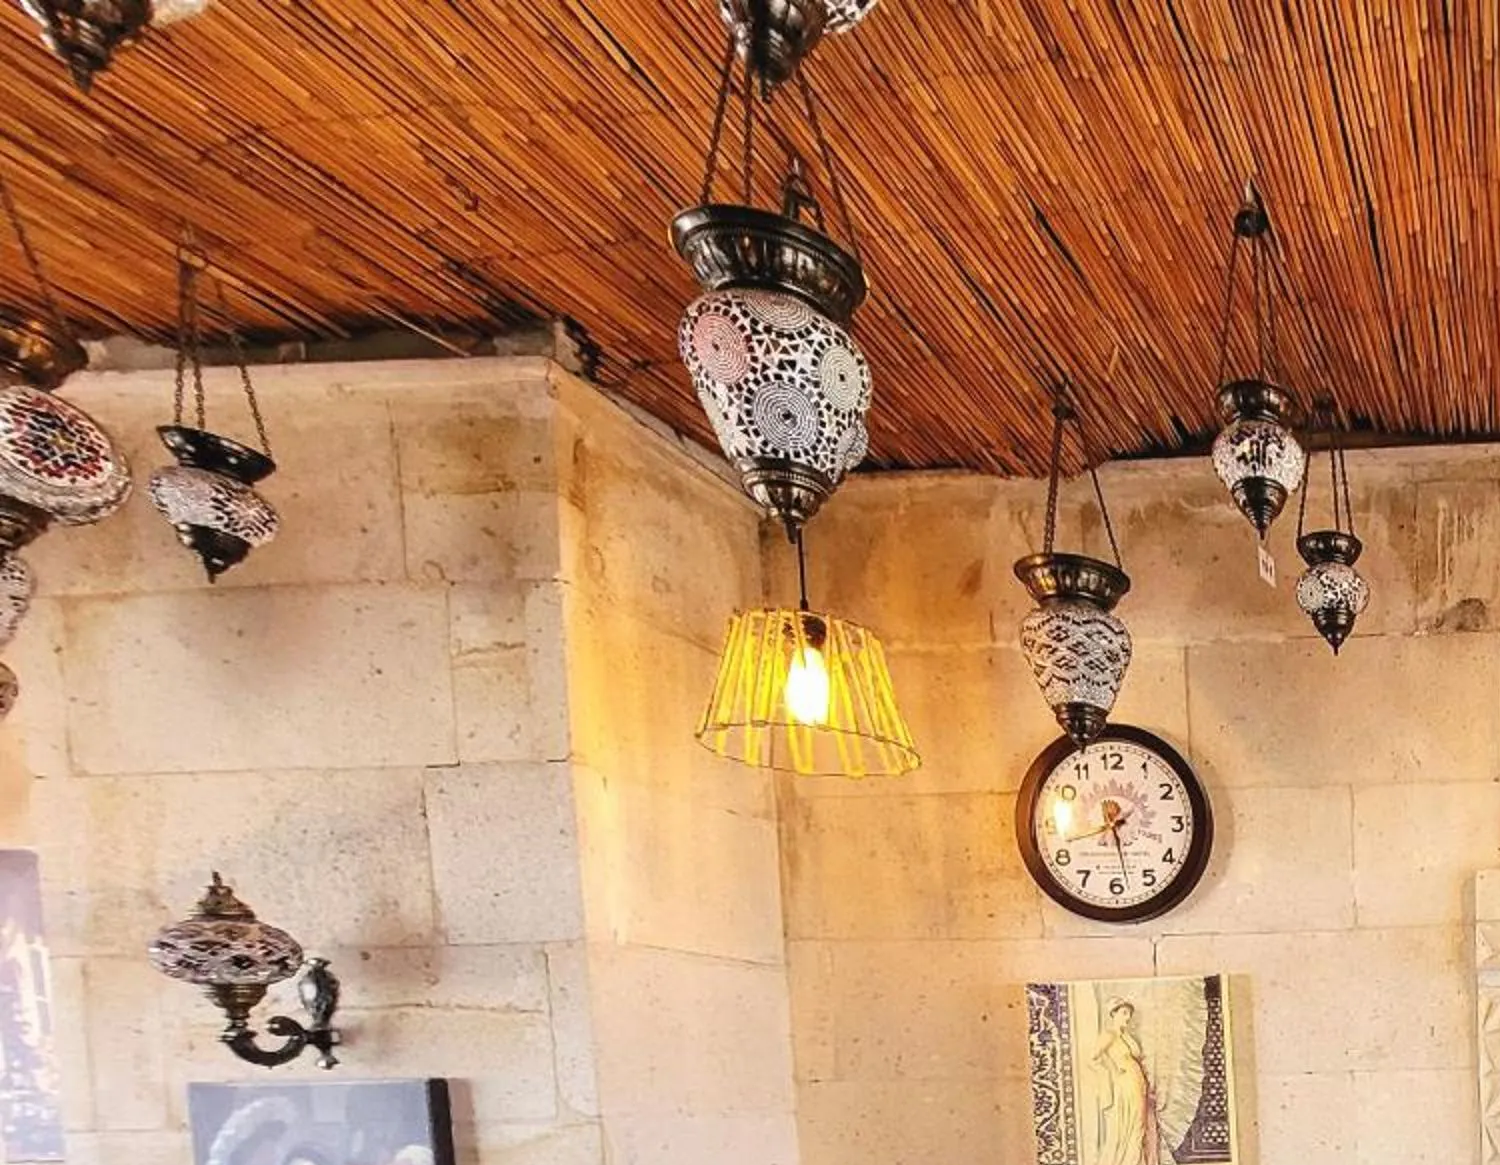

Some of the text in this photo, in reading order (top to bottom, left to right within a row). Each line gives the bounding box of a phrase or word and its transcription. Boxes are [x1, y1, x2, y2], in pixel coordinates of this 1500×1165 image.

[1100, 753, 1125, 771] 12
[1140, 762, 1149, 779] 1
[1073, 763, 1089, 780] 11
[1054, 784, 1077, 801] 0
[1159, 783, 1174, 801] 2
[1170, 815, 1185, 833] 3
[1055, 849, 1071, 866] 8
[1161, 848, 1176, 865] 4
[1076, 869, 1092, 888] 7
[1108, 878, 1125, 895] 6
[1142, 869, 1156, 887] 5
